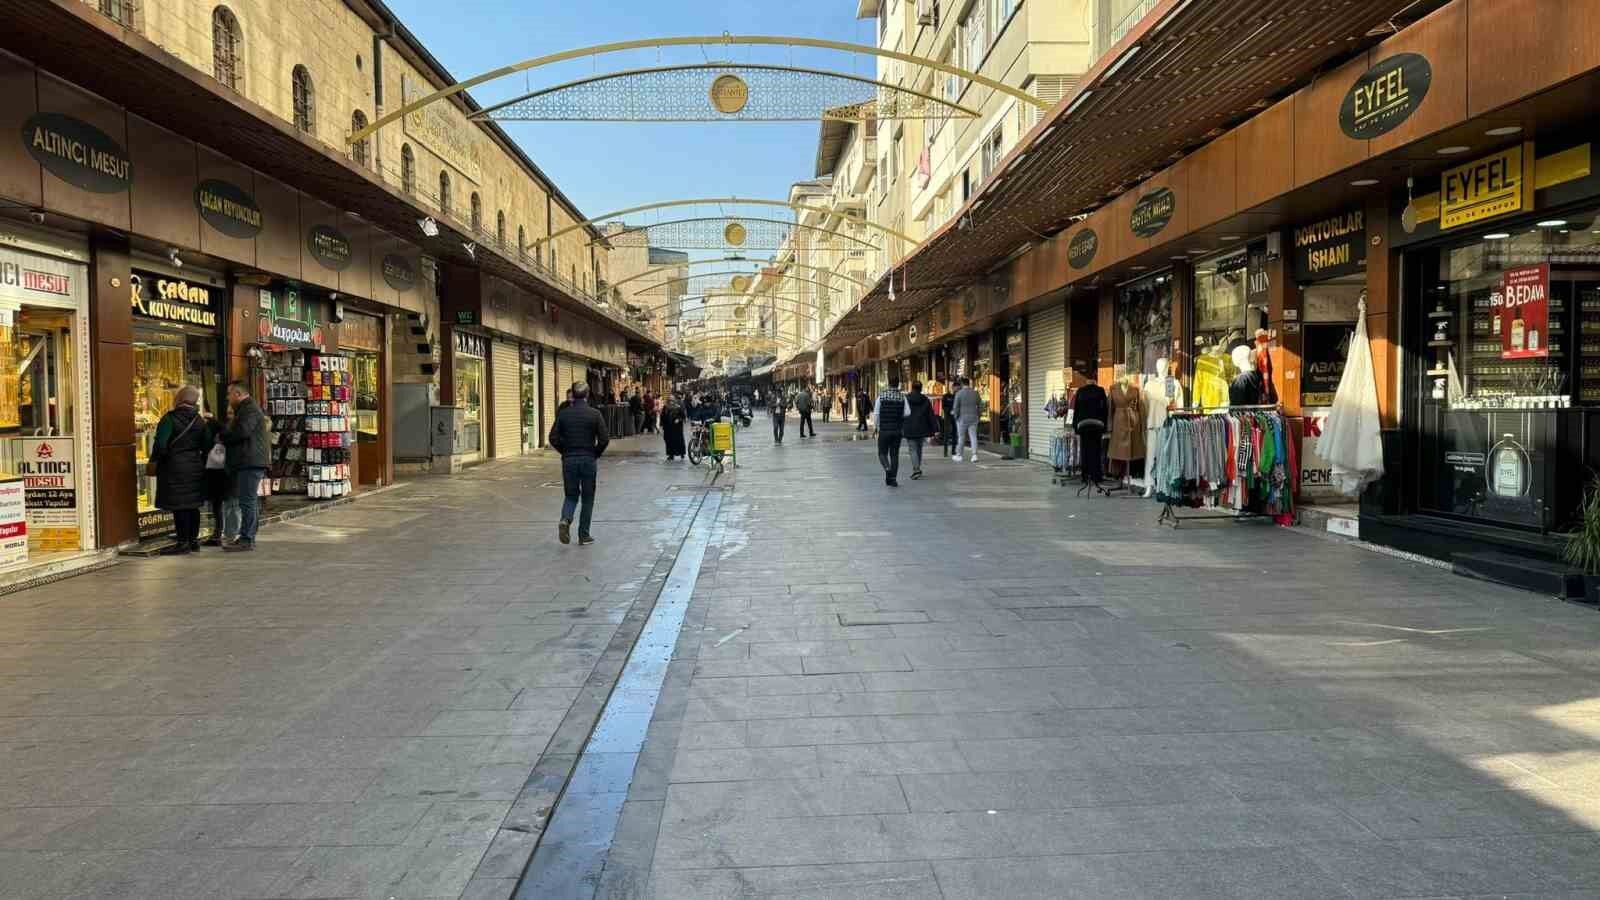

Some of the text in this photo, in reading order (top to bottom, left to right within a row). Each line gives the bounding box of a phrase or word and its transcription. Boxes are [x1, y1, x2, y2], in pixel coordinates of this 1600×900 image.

[1354, 67, 1408, 117] EYFEL
[33, 126, 130, 180] ALTINCI MESUT
[1446, 156, 1514, 206] EYFEL
[1295, 211, 1363, 247] DOKTORLAR
[157, 279, 209, 305] ÇAĞAN
[1505, 284, 1545, 308] BEDAVA
[149, 301, 215, 326] KUYUMCULUK
[18, 461, 71, 474] ALTINCI
